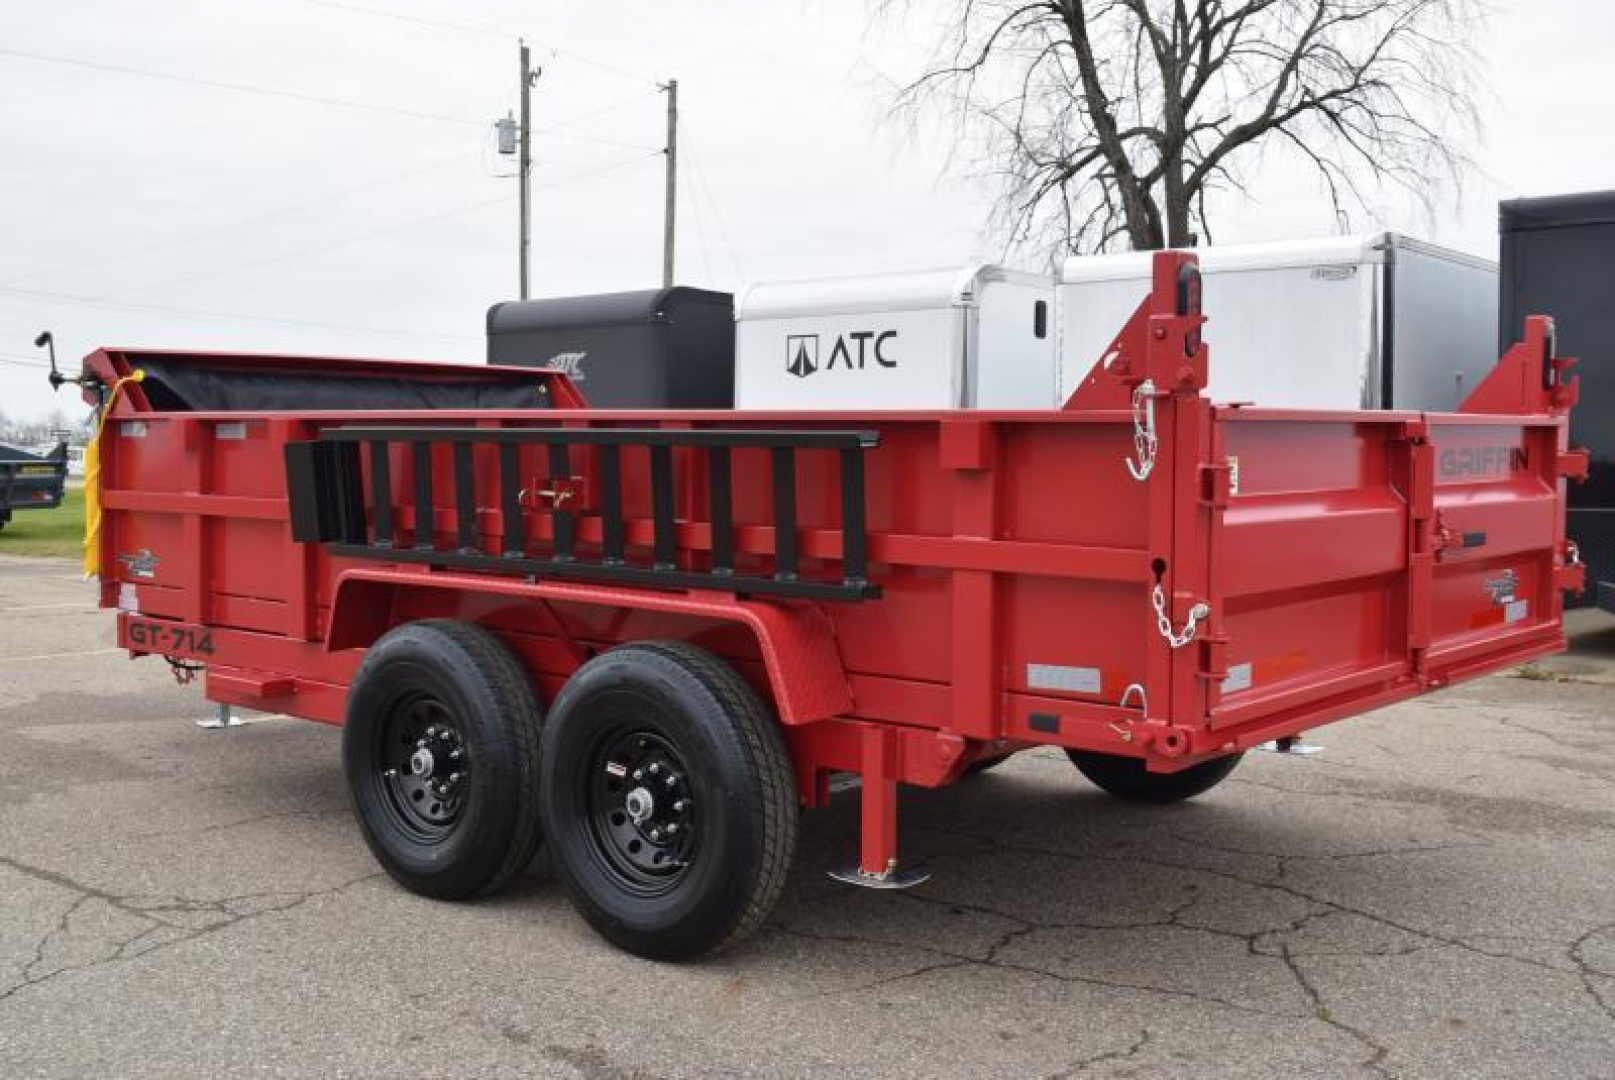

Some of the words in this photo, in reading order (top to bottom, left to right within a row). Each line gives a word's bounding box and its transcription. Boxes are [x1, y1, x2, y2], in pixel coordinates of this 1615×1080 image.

[826, 330, 897, 370] ATC
[1440, 445, 1529, 476] GRIFFIN
[130, 623, 215, 656] GT-714
